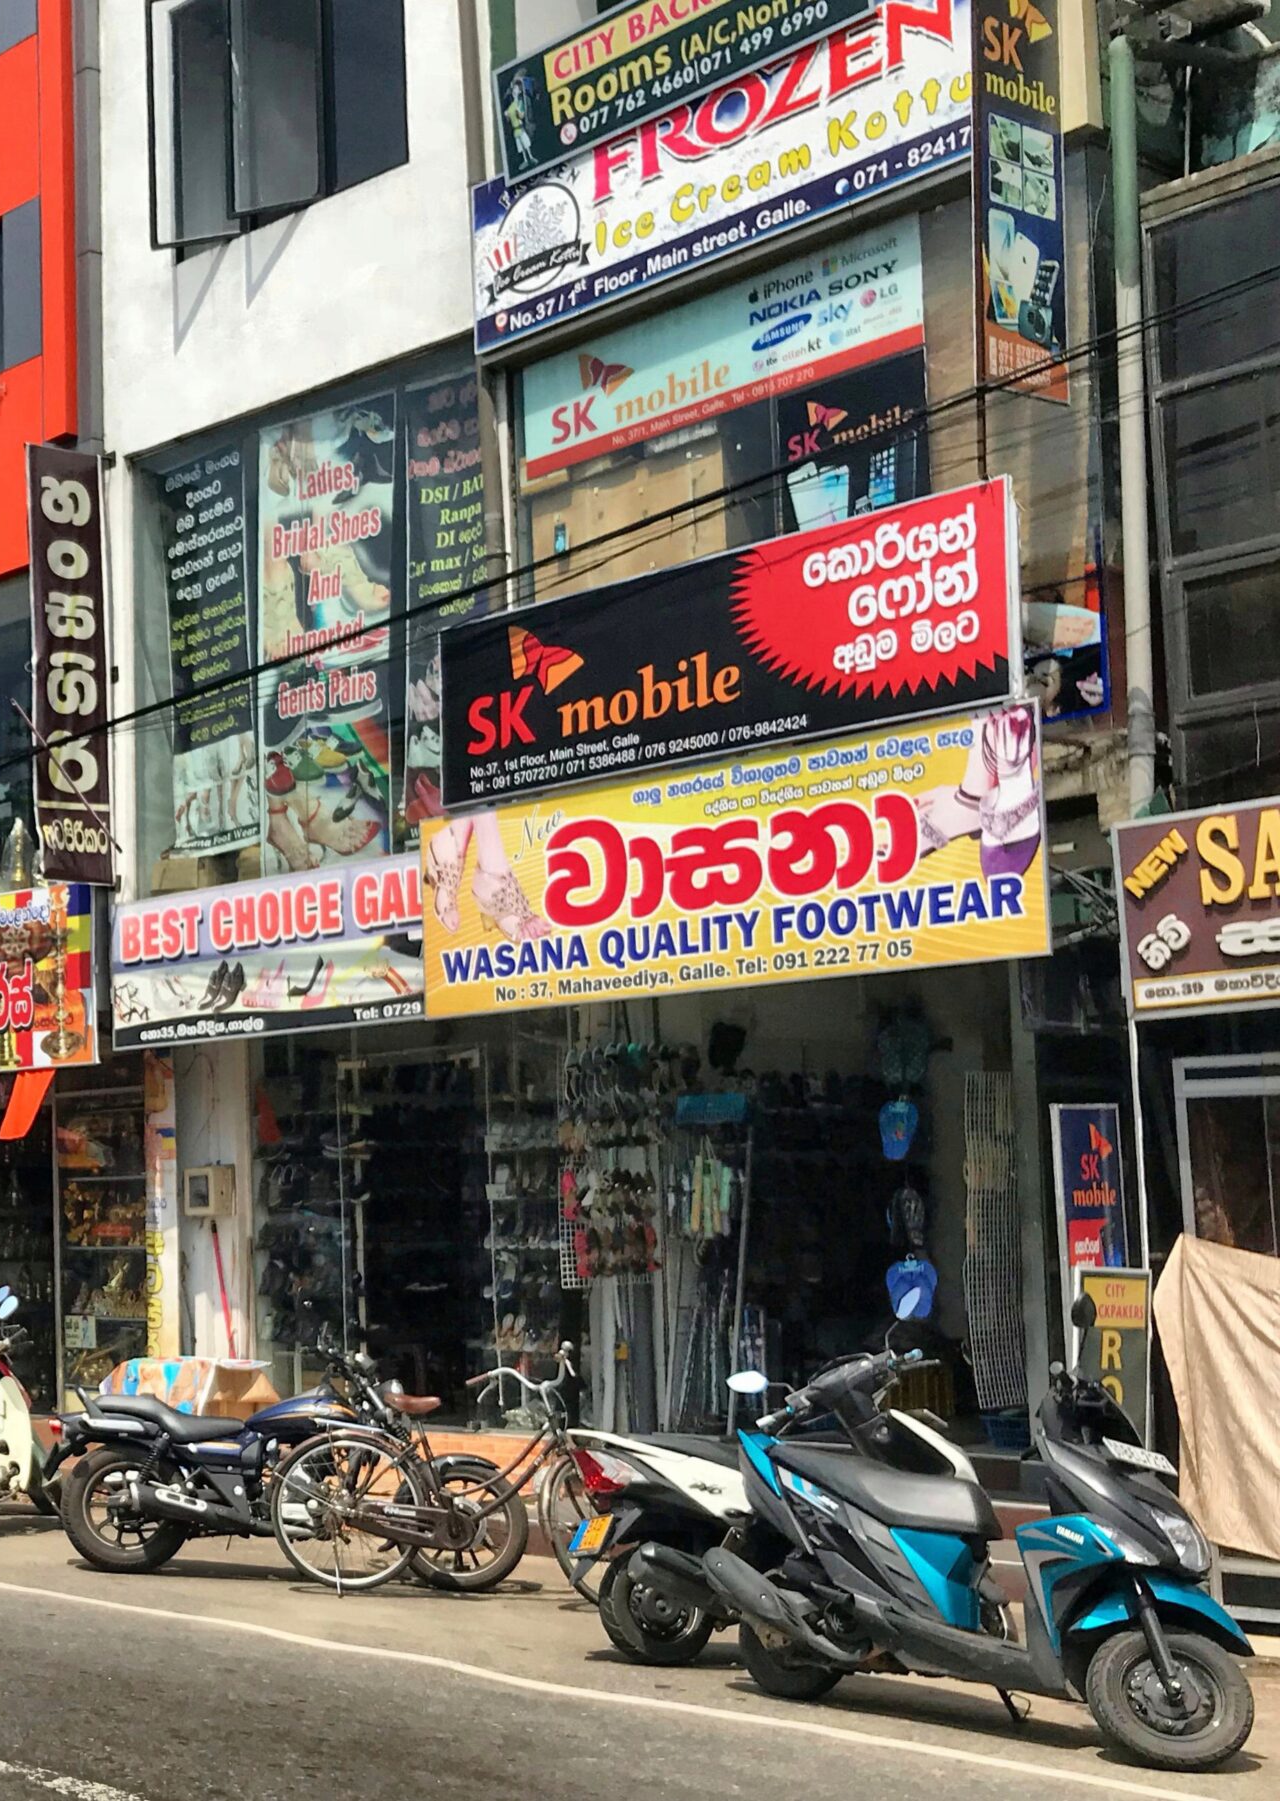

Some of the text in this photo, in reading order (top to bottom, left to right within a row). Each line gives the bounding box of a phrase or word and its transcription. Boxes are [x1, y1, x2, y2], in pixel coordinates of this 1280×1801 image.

[552, 27, 614, 79] CITY
[580, 104, 608, 135] 077
[615, 94, 646, 119] 762
[739, 28, 773, 57] 499
[780, 5, 829, 38] 6990
[983, 16, 1023, 71] SK
[552, 45, 672, 126] Rooms
[592, 0, 954, 202] FROZEN
[985, 71, 1056, 116] mobile
[595, 211, 655, 257] Ice
[670, 143, 811, 223] Cream
[827, 71, 971, 157] Kottu
[593, 267, 637, 297] Floor
[692, 221, 747, 257] street
[853, 160, 888, 190] 071
[749, 288, 822, 326] NOKIA
[828, 258, 898, 297] SONY
[763, 236, 899, 299] iPhone Microsoft
[758, 318, 806, 345] SAMSUNG
[879, 283, 899, 299] LG
[551, 396, 598, 444] SK
[614, 359, 730, 425] mobile
[786, 429, 821, 463] SK
[297, 460, 359, 501] Ladies,
[420, 486, 451, 505] DSI
[802, 502, 978, 588] කොරියන්
[309, 564, 341, 604] And
[848, 548, 979, 627] ෆෝන්
[286, 610, 365, 666] Imported
[832, 610, 980, 675] අඩුම මිලට
[279, 678, 326, 718] Gents
[329, 666, 376, 707] Pairs
[467, 651, 741, 755] SK mobile
[470, 781, 484, 794] Tel
[492, 775, 511, 790] 091
[513, 765, 558, 784] 5707270
[566, 759, 587, 775] 071
[588, 748, 636, 769] 5386488
[644, 742, 666, 759] 076
[668, 730, 719, 754] 9245000
[728, 713, 808, 742] 076-9842424
[503, 759, 518, 772] 1st
[549, 747, 574, 762] Main
[612, 733, 640, 750] Galle
[514, 804, 565, 862] New
[544, 793, 918, 927] වාසනා
[1123, 828, 1189, 899] NEW
[120, 866, 423, 964] BEST CHOICE GAL
[442, 876, 1023, 984] WASANA QUALITY FOOTWEAR
[496, 984, 517, 1001] No
[558, 967, 674, 996] Mahaveediya,
[679, 962, 731, 981] Galle.
[735, 956, 768, 976] Tel:
[773, 952, 808, 971] 091
[814, 946, 850, 967] 222
[857, 942, 880, 961] 77
[887, 940, 912, 958] 05
[353, 1001, 422, 1021] Tel: 0729
[1072, 1188, 1117, 1208] mobile
[1080, 1154, 1100, 1181] SK
[1105, 1283, 1126, 1298] CITY
[1056, 1524, 1085, 1546] YAMAHA
